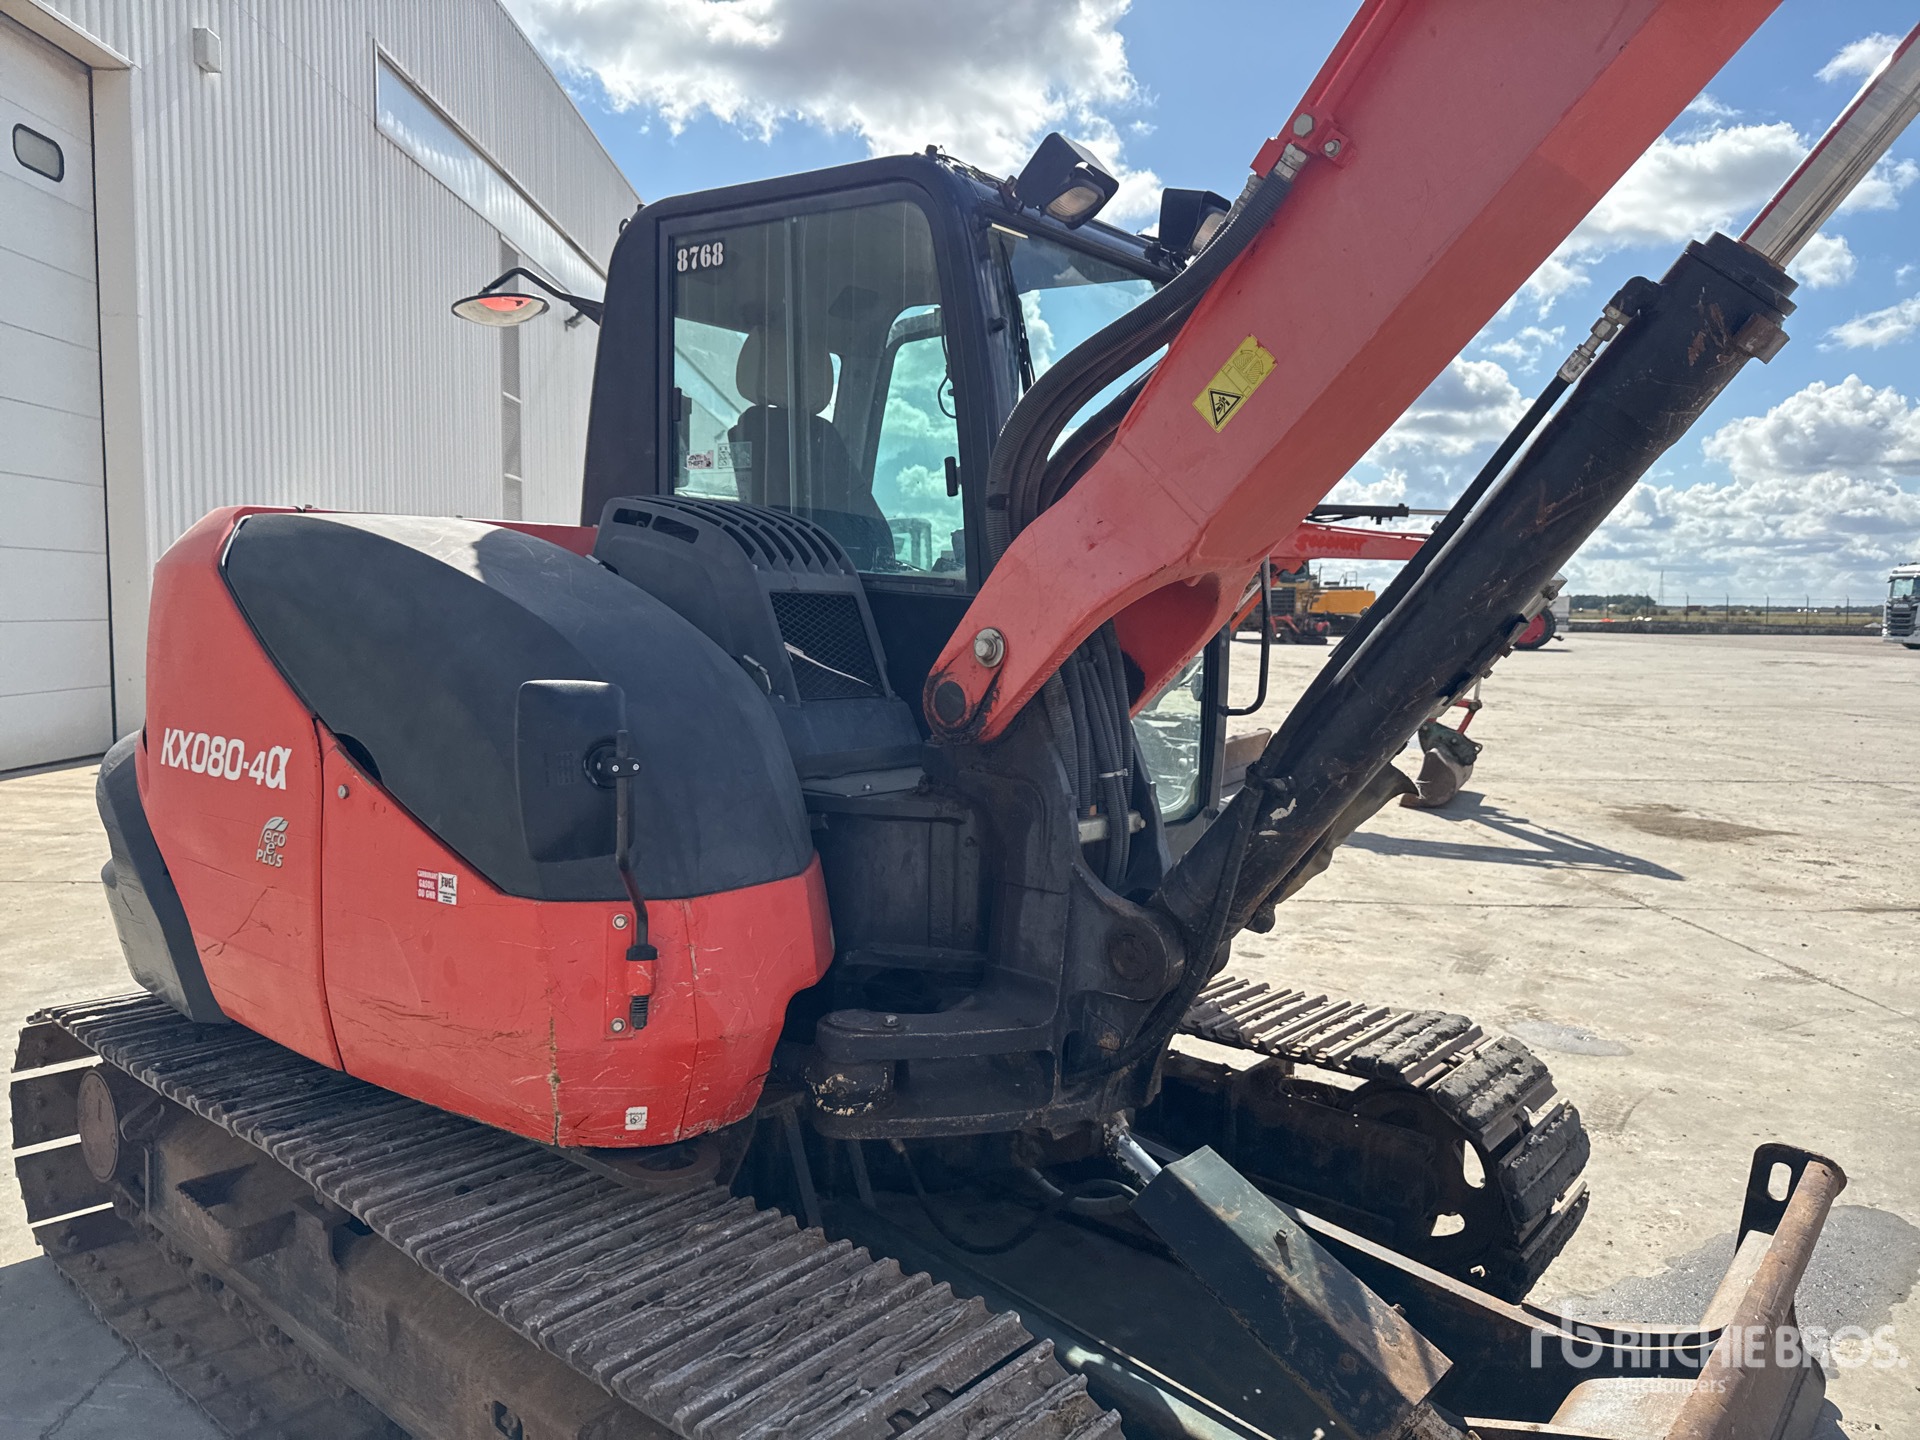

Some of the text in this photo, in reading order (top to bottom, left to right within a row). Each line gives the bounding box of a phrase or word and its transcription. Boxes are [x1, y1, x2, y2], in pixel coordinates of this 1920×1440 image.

[676, 241, 724, 272] 8768
[264, 830, 286, 847] eco
[255, 849, 283, 867] PLUS
[441, 876, 455, 889] FUEL
